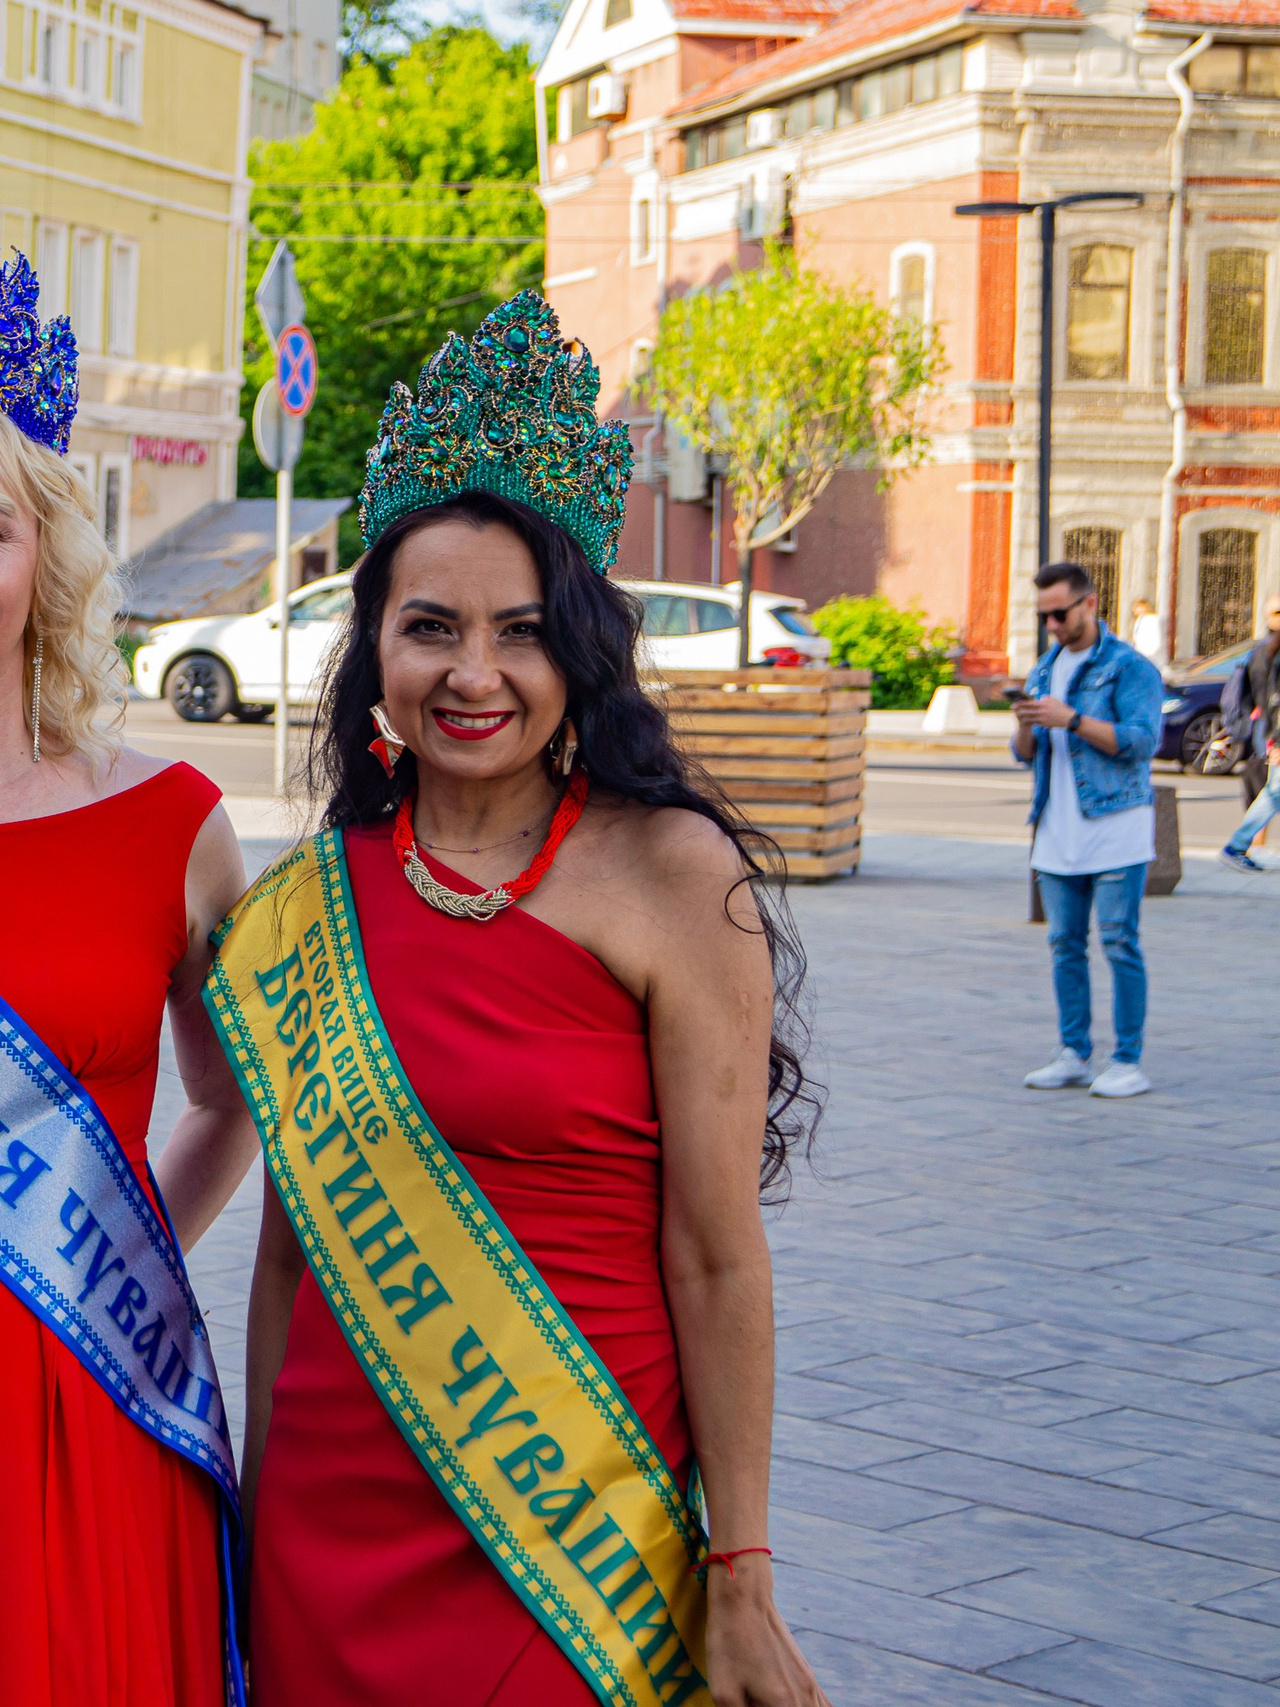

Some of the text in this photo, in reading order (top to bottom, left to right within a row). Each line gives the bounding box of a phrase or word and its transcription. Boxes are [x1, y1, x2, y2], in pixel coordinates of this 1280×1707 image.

[254, 942, 454, 1336] БЕРЕГИНЯ
[304, 920, 389, 1145] ВТОРАЯ ВИЦЕ
